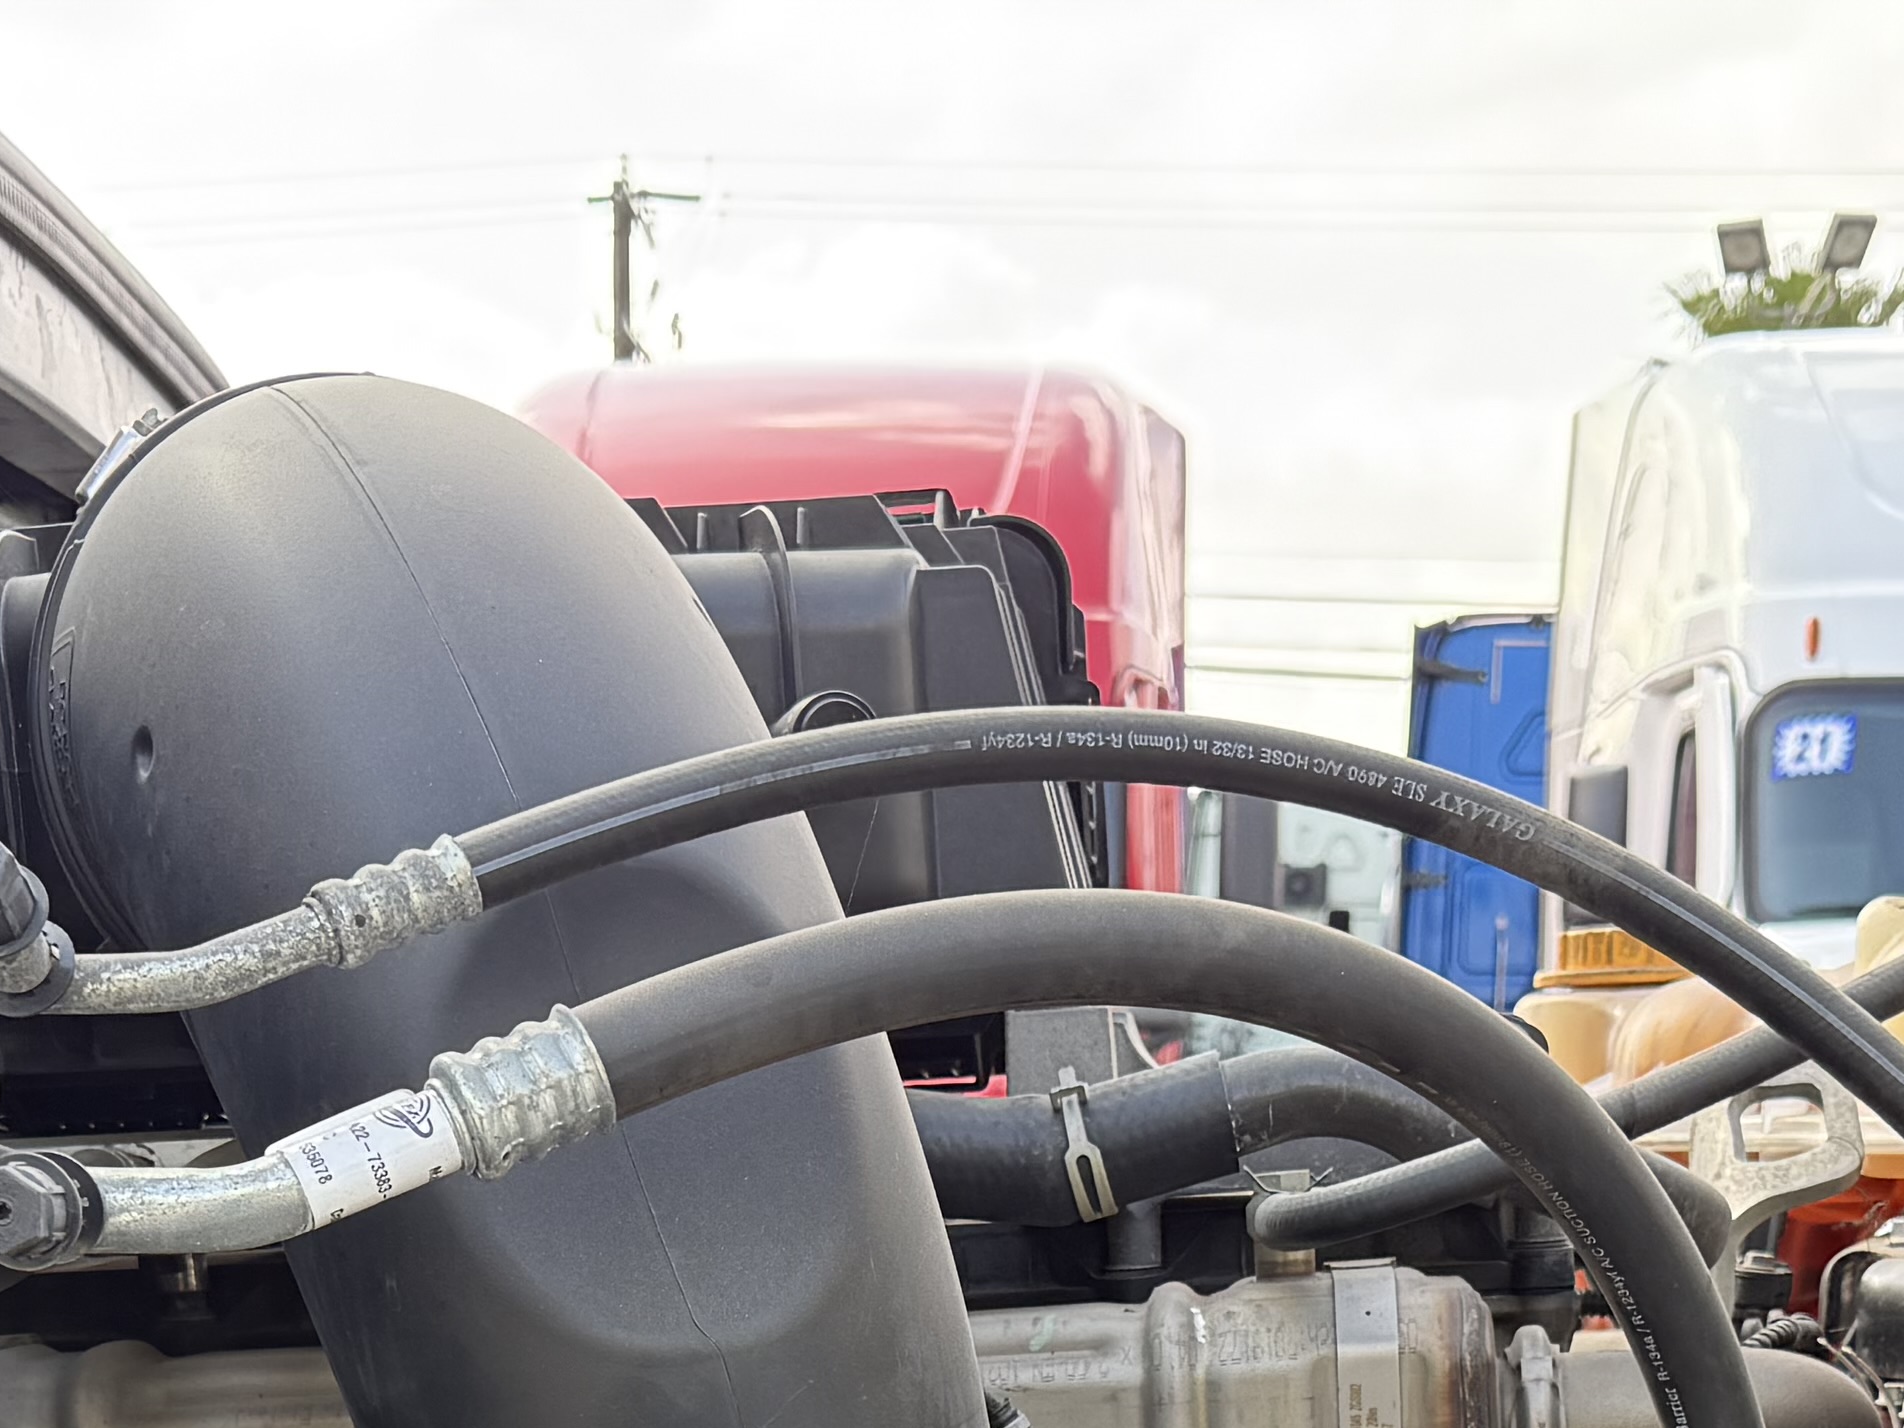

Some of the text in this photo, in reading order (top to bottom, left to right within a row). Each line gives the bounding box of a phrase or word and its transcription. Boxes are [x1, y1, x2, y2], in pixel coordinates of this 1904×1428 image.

[1065, 729, 1123, 748] R-134a
[1128, 731, 1188, 753] (10mm)
[1211, 740, 1255, 763] 13/32
[1259, 746, 1309, 772] HOSE
[1313, 756, 1343, 780] A/C
[1348, 764, 1387, 788] 4890
[1394, 775, 1427, 800] SLE
[1429, 788, 1536, 842] GALAXY
